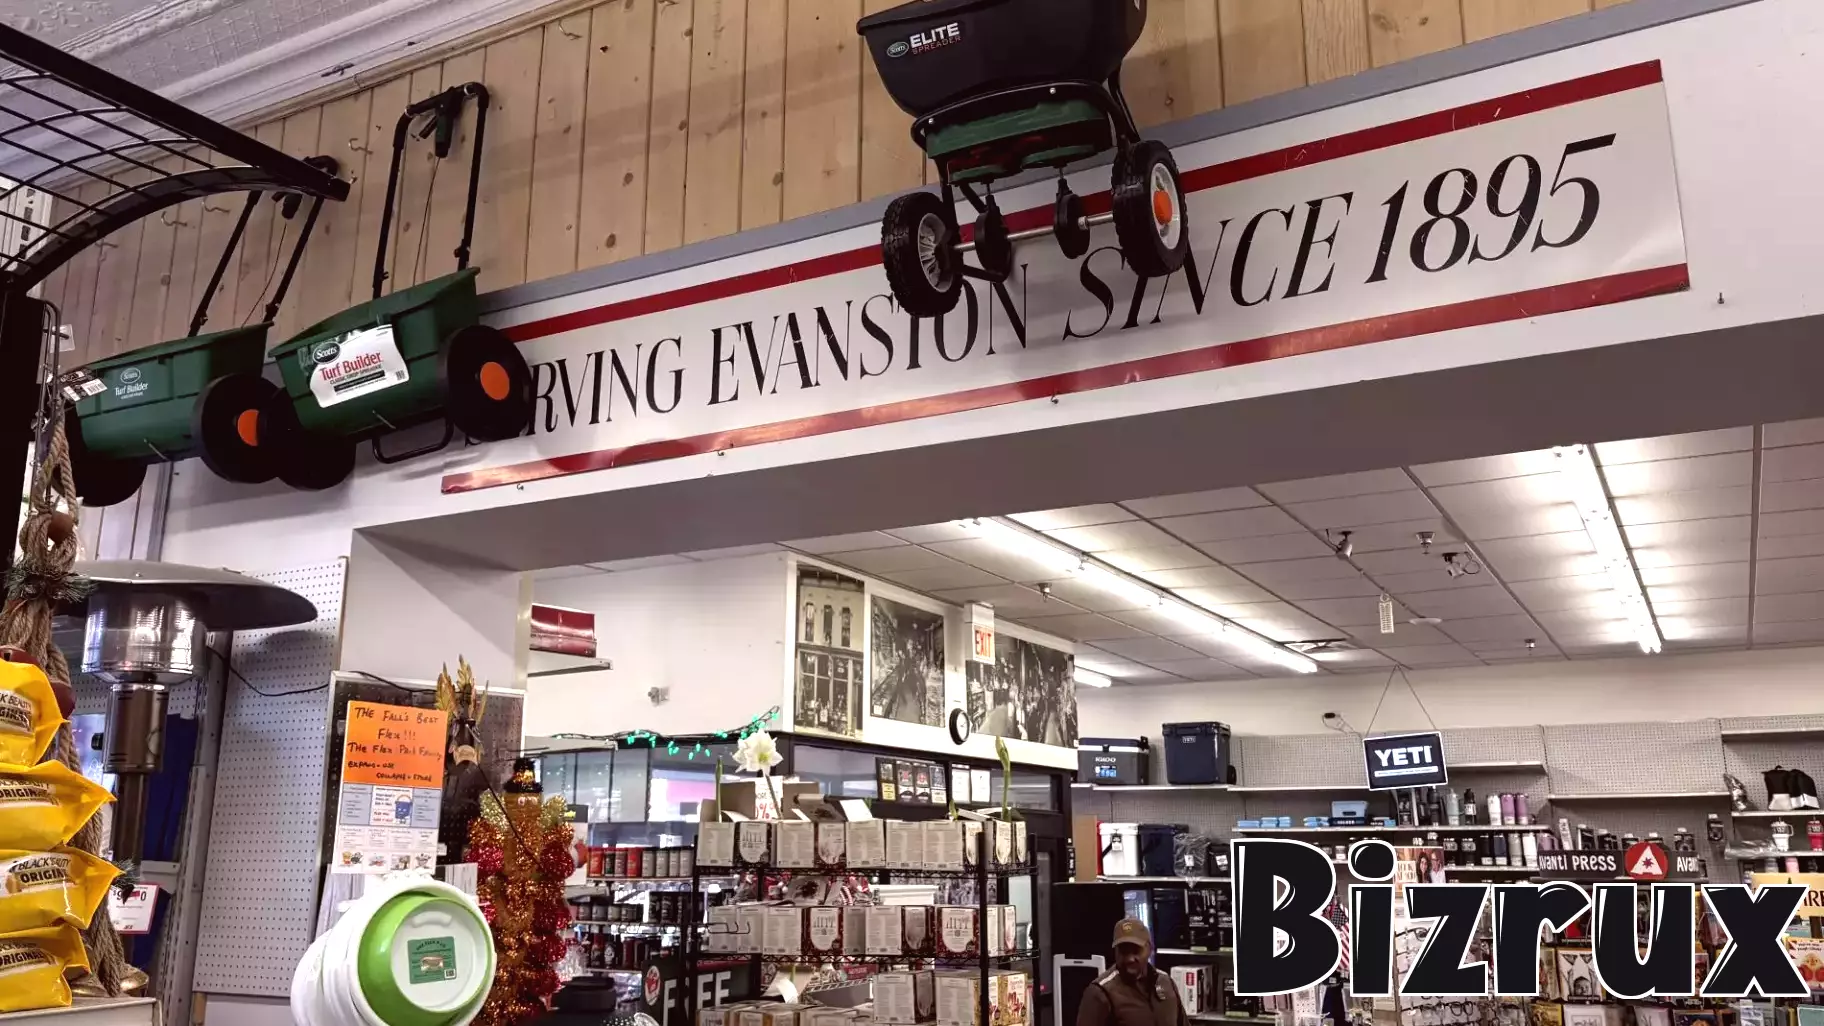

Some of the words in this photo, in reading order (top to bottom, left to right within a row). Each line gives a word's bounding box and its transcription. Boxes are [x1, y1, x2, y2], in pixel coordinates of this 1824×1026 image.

[909, 22, 961, 49] ELITE
[911, 35, 962, 55] SPREADER
[465, 336, 682, 447] RVING
[1063, 191, 1354, 340] SINCE
[1364, 133, 1616, 284] 1895
[316, 345, 338, 360] Scotts
[320, 363, 341, 381] Turf
[342, 351, 384, 374] Builder
[114, 386, 127, 397] Turf
[126, 381, 149, 394] Builder
[974, 629, 992, 658] EXIT
[354, 707, 375, 719] THE
[1374, 745, 1433, 767] YETI
